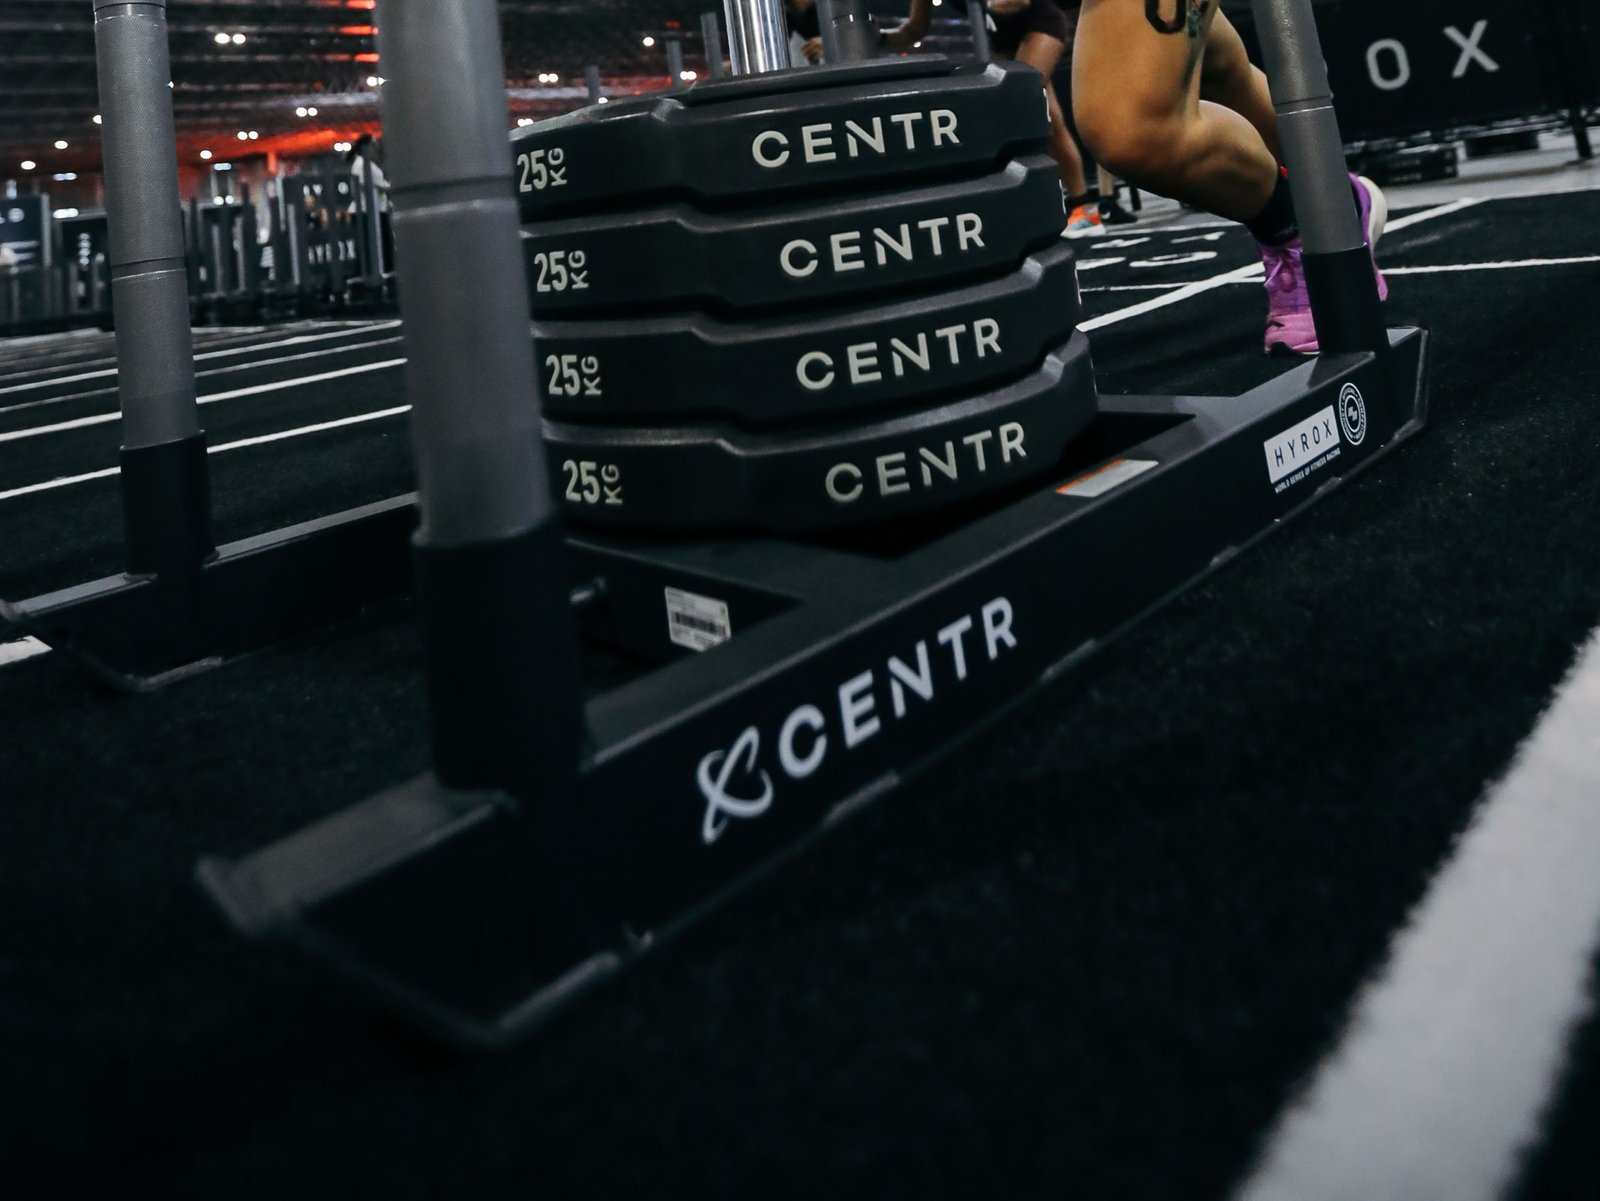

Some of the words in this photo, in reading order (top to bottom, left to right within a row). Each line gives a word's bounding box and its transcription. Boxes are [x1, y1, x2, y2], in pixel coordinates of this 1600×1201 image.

[751, 108, 960, 168] CENTR
[517, 149, 548, 193] 25
[548, 147, 568, 187] KG
[534, 250, 570, 293] 25
[570, 249, 589, 290] KG
[780, 212, 985, 277] CENTR
[545, 354, 580, 396] 25
[580, 355, 602, 396] KG
[796, 317, 1003, 391] CENTR
[825, 421, 1027, 502] CENTR
[1274, 419, 1333, 468] HYROX
[562, 459, 600, 504] 25
[601, 463, 623, 505] KG
[778, 596, 1017, 778] CENTR
